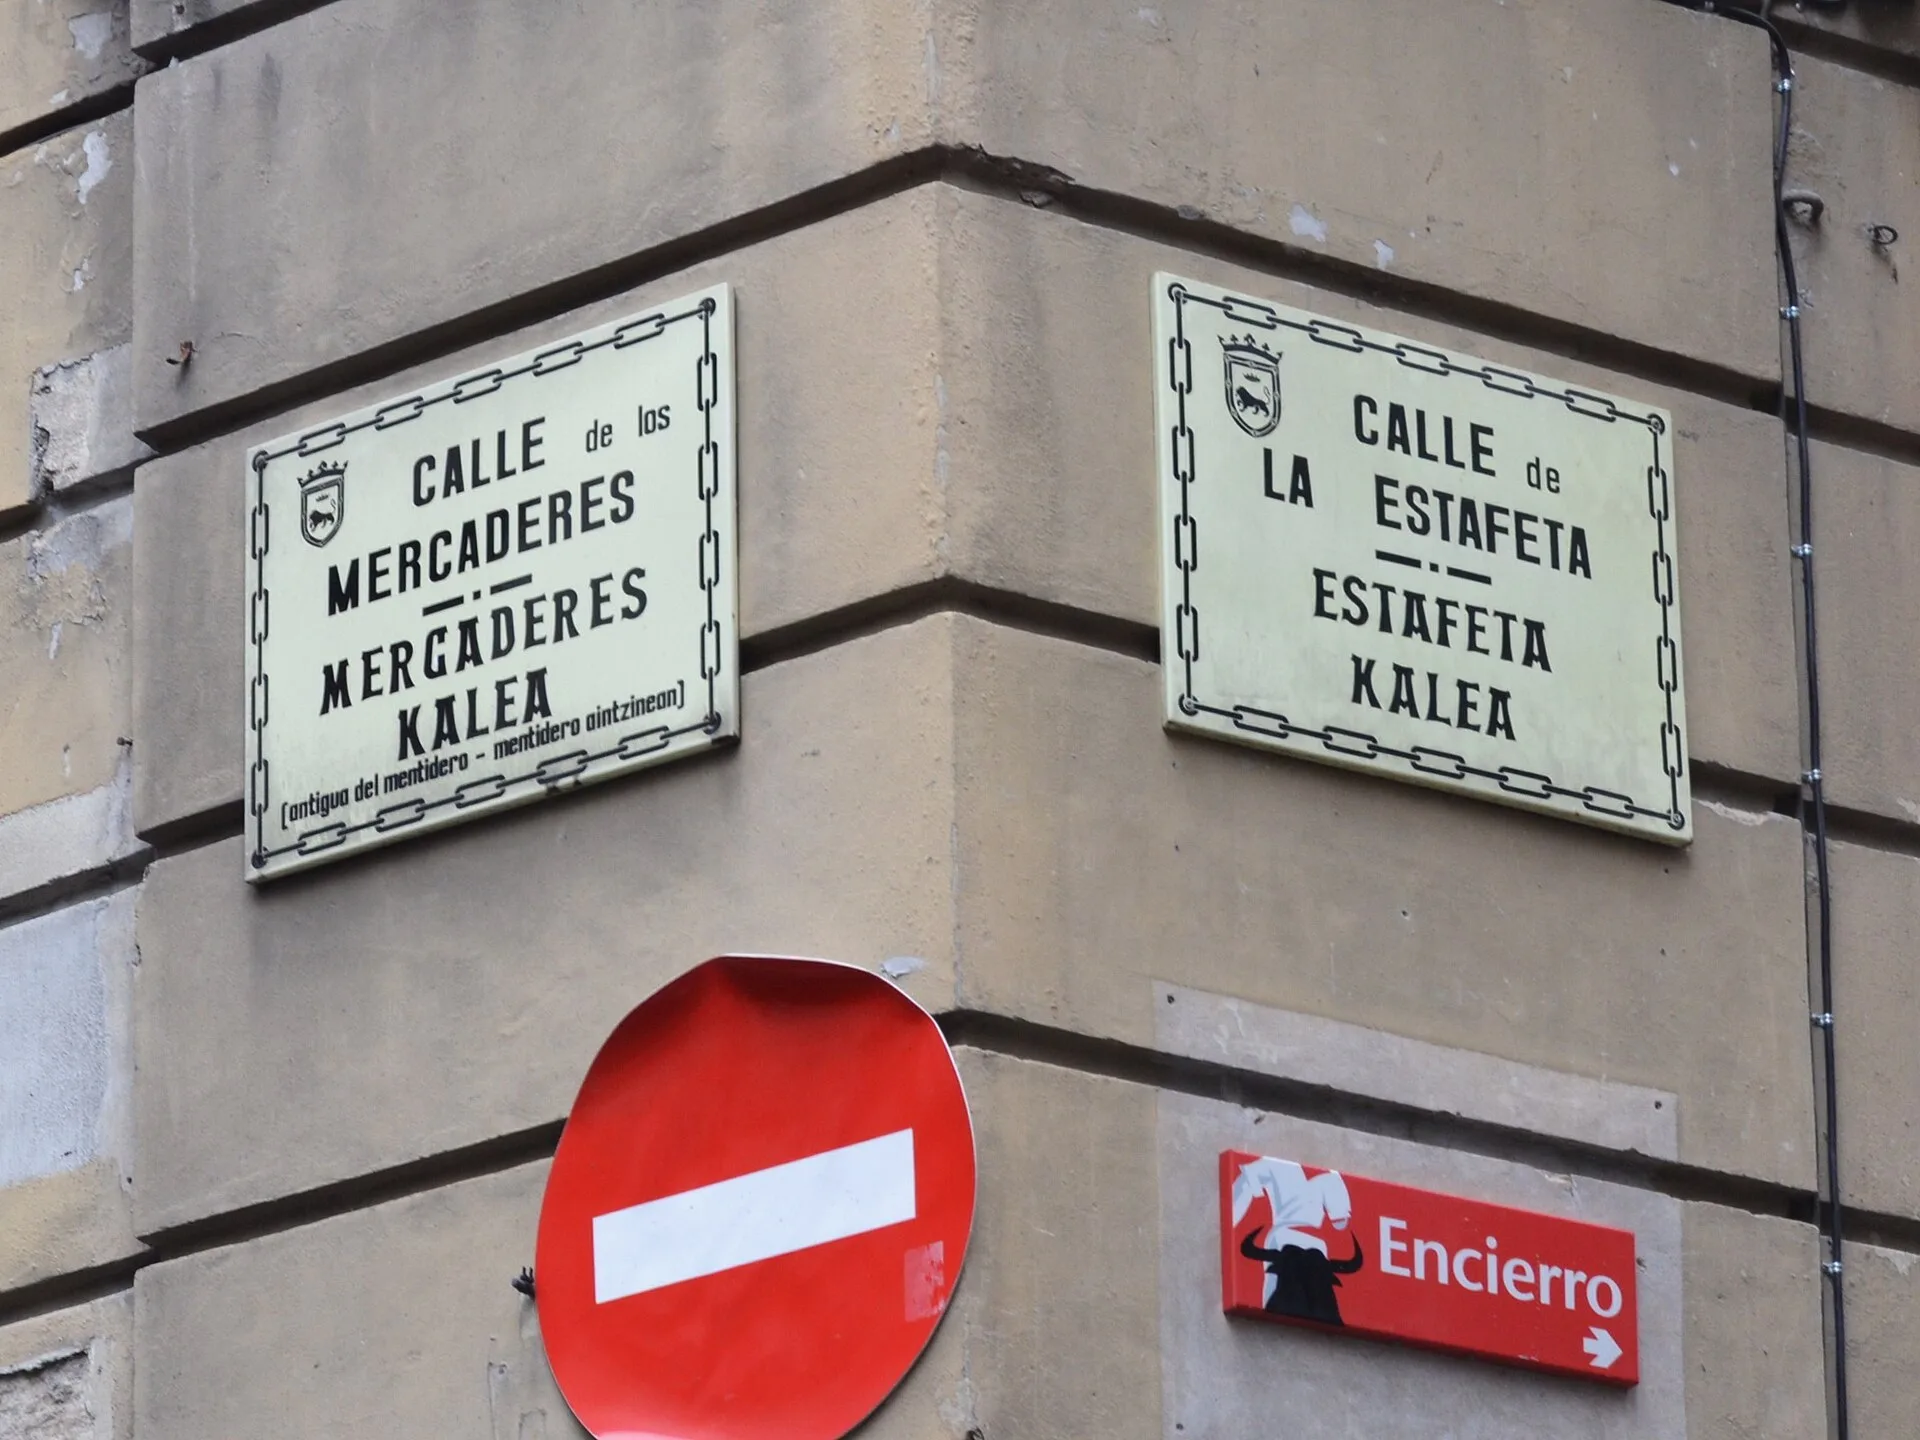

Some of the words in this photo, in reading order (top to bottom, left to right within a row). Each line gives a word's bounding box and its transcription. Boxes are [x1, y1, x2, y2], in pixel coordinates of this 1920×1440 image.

[413, 416, 546, 507] CALLE
[585, 419, 613, 452] de
[638, 404, 671, 437] los
[1353, 395, 1497, 477] CALLE
[1526, 457, 1561, 494] de
[328, 470, 635, 616] MERCADERES
[1263, 448, 1314, 508] LA
[1375, 474, 1592, 579] ESTAFETA
[1313, 568, 1552, 673] ESTAFETA
[398, 667, 553, 761] KALEA
[1350, 654, 1517, 741] KALEA
[354, 774, 379, 800] del
[383, 753, 468, 790] mentidero
[494, 718, 580, 760] mentidero
[1379, 1216, 1622, 1319] Encierro
